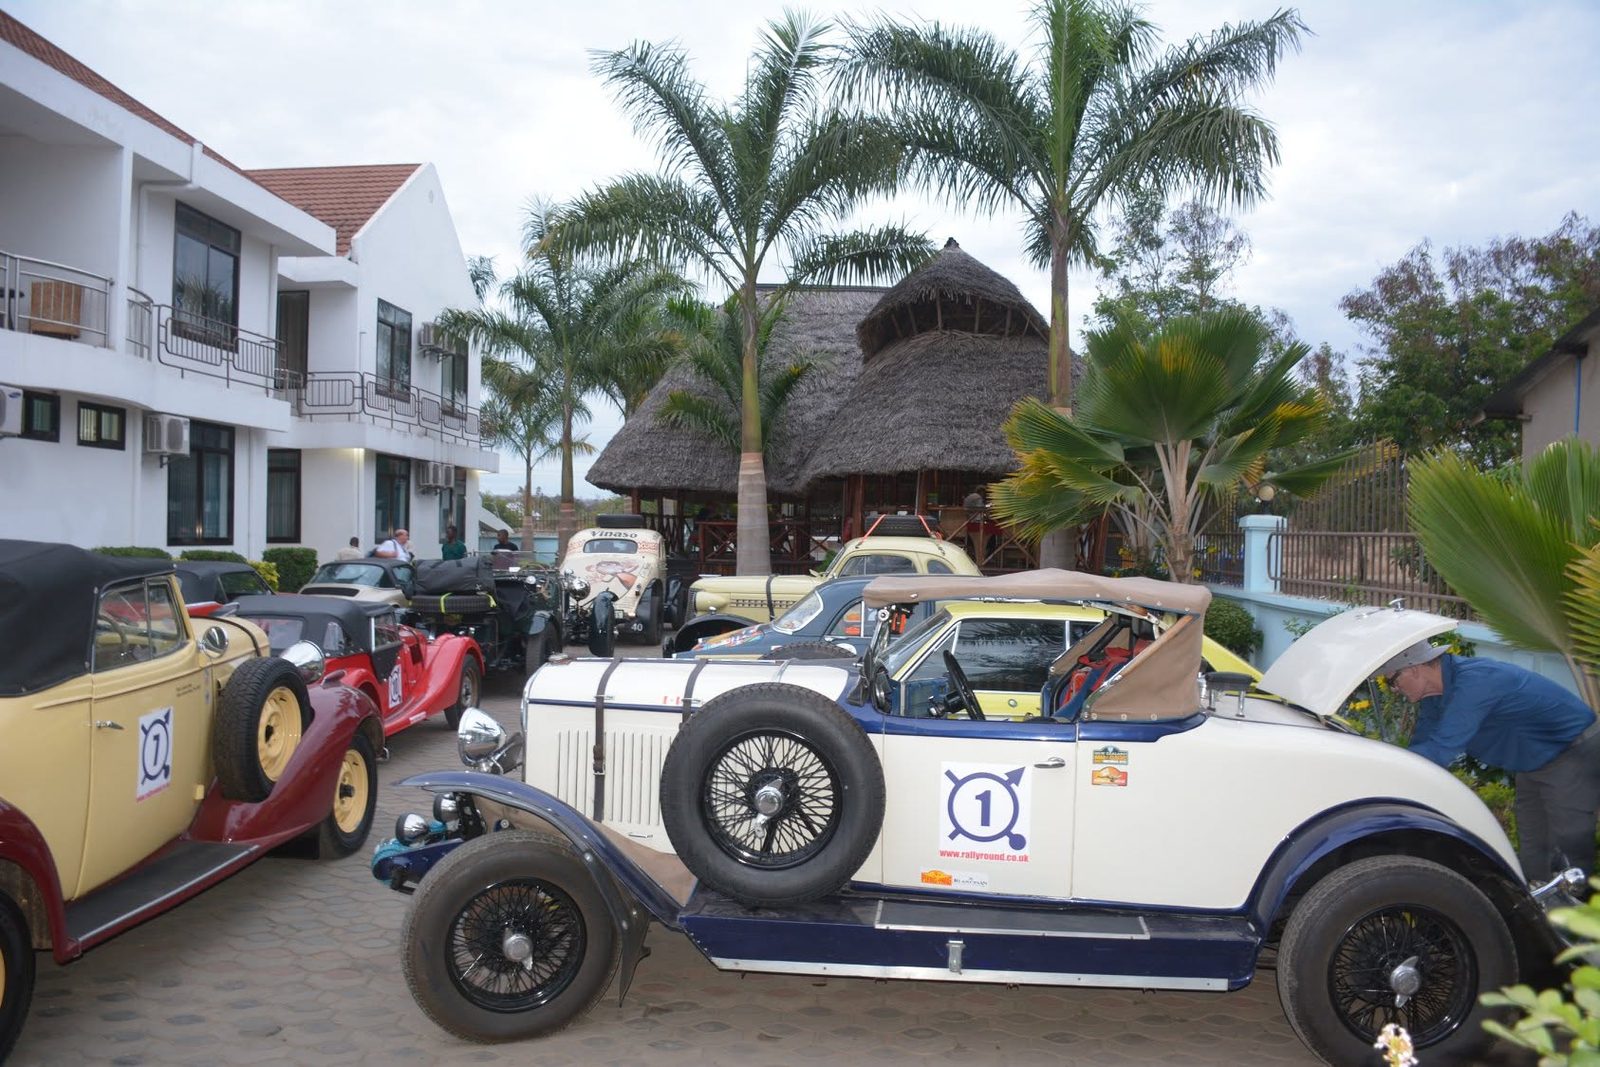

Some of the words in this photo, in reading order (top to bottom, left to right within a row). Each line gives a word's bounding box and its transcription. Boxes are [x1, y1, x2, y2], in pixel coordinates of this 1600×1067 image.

[591, 530, 638, 538] Vinaso
[631, 623, 643, 631] 40
[975, 790, 991, 826] 1
[939, 850, 1029, 862] www.rallyround.co.uk
